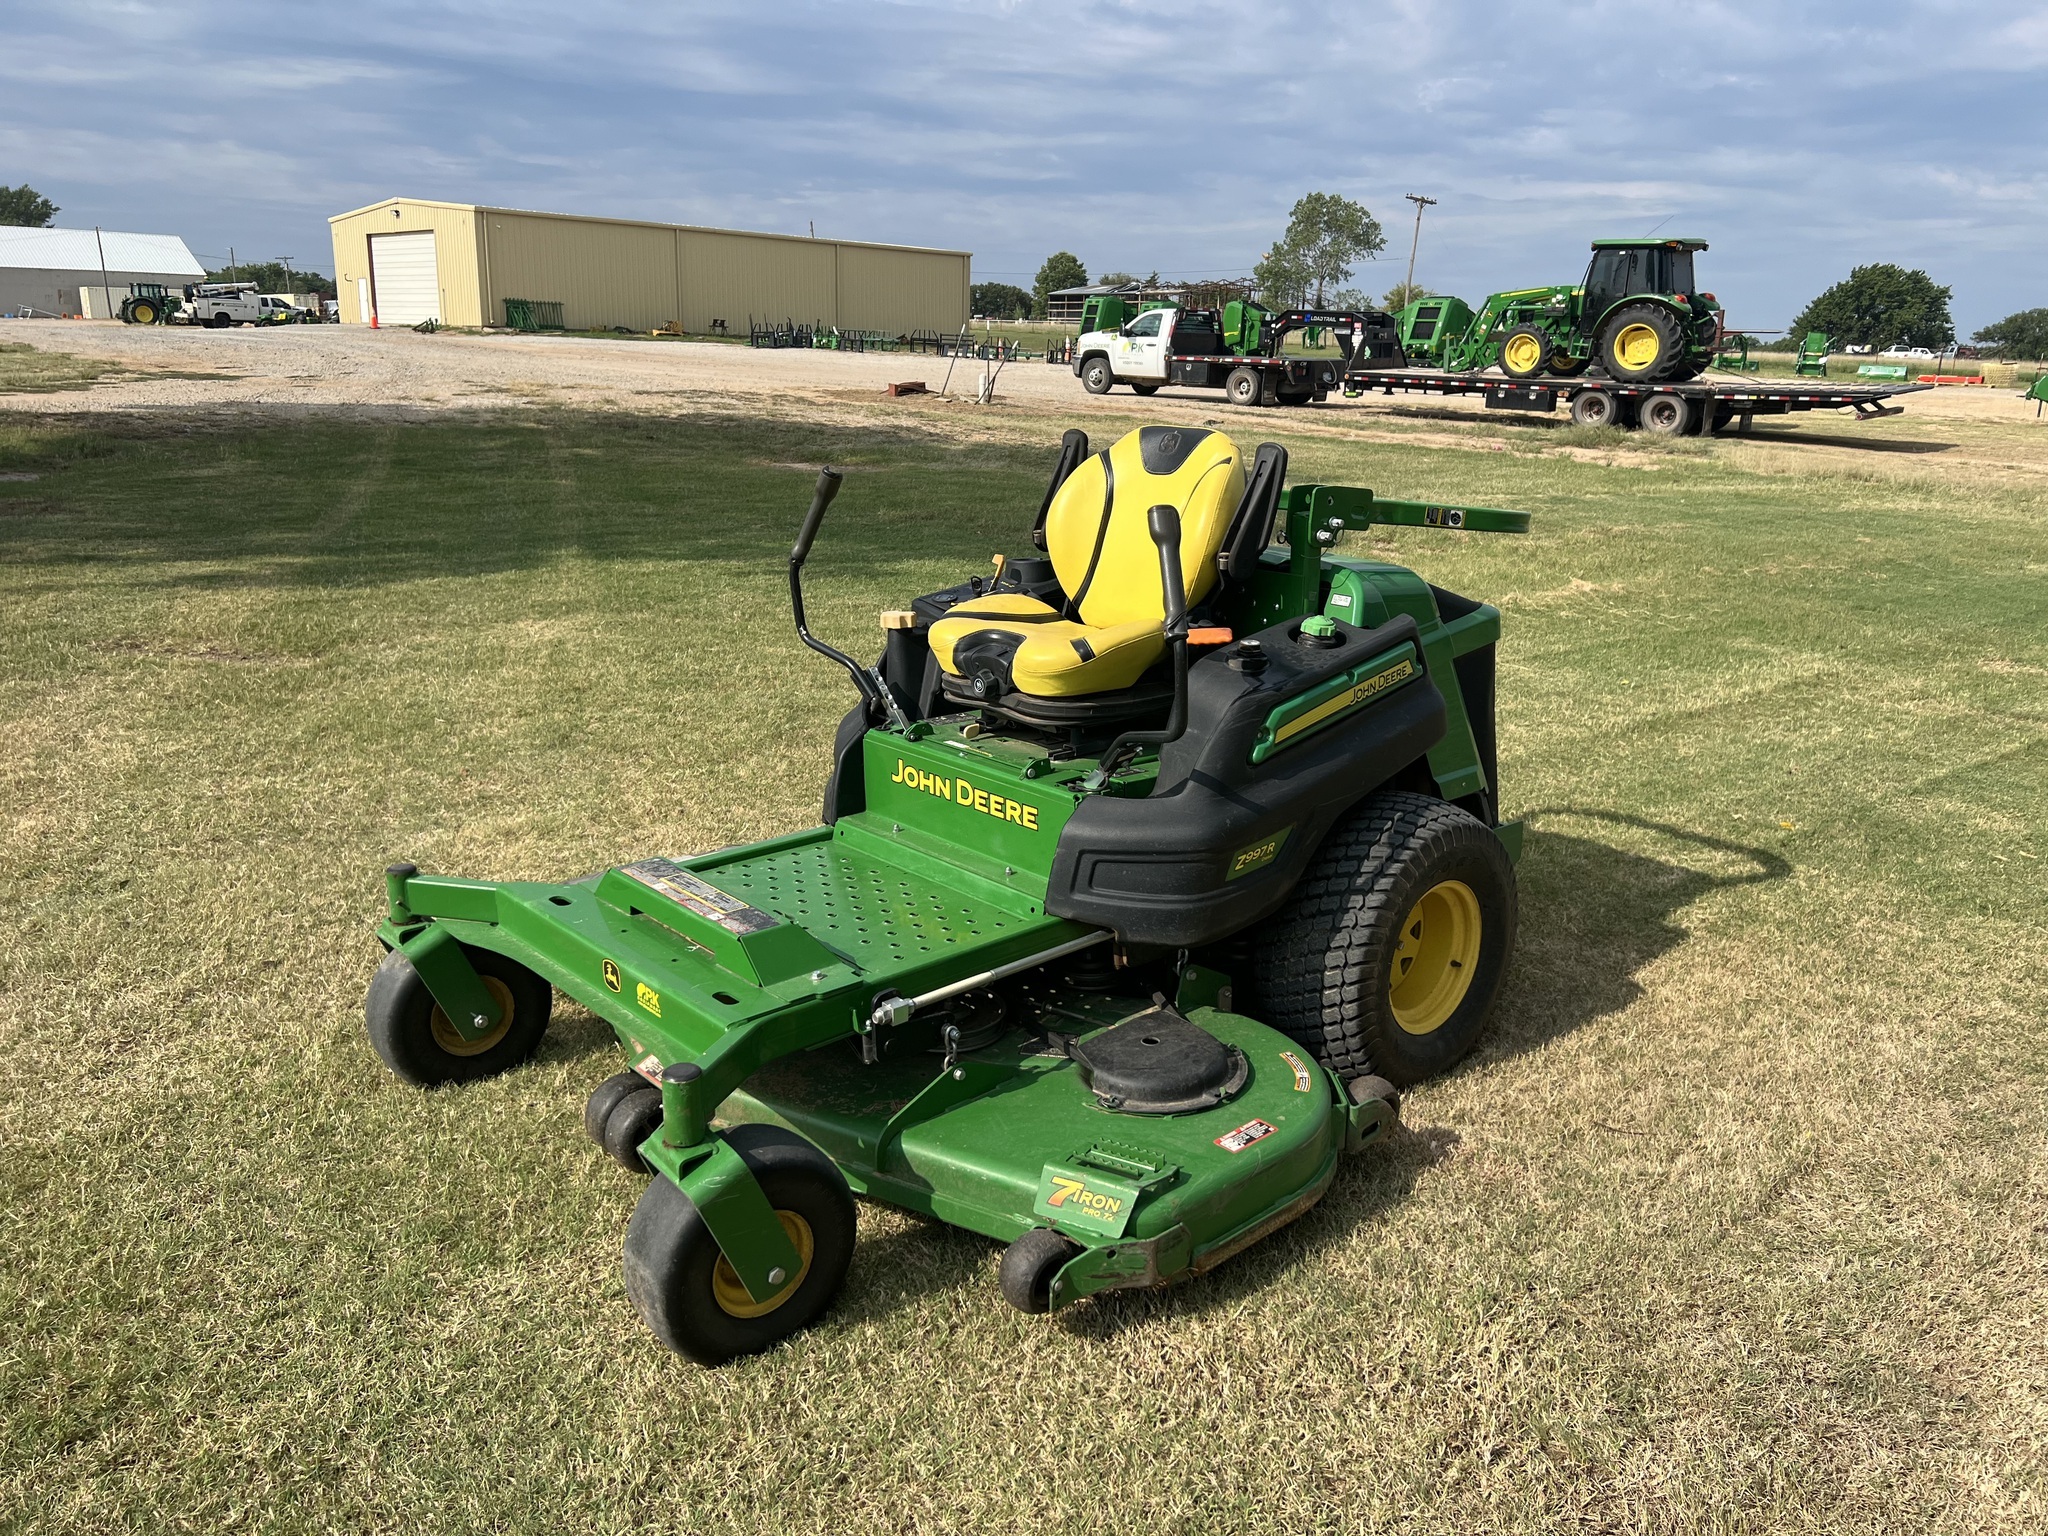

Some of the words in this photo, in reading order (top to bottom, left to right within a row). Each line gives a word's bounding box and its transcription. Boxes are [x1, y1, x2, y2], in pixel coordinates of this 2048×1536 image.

[1350, 680, 1377, 706] JOHN
[1377, 664, 1409, 692] DEERE
[891, 757, 952, 802] JOHN
[955, 776, 1040, 832] DEERE
[1234, 841, 1276, 871] Z997R
[1071, 1188, 1122, 1214] IRON
[1081, 1206, 1102, 1219] PRO
[1102, 1211, 1116, 1222] 72
